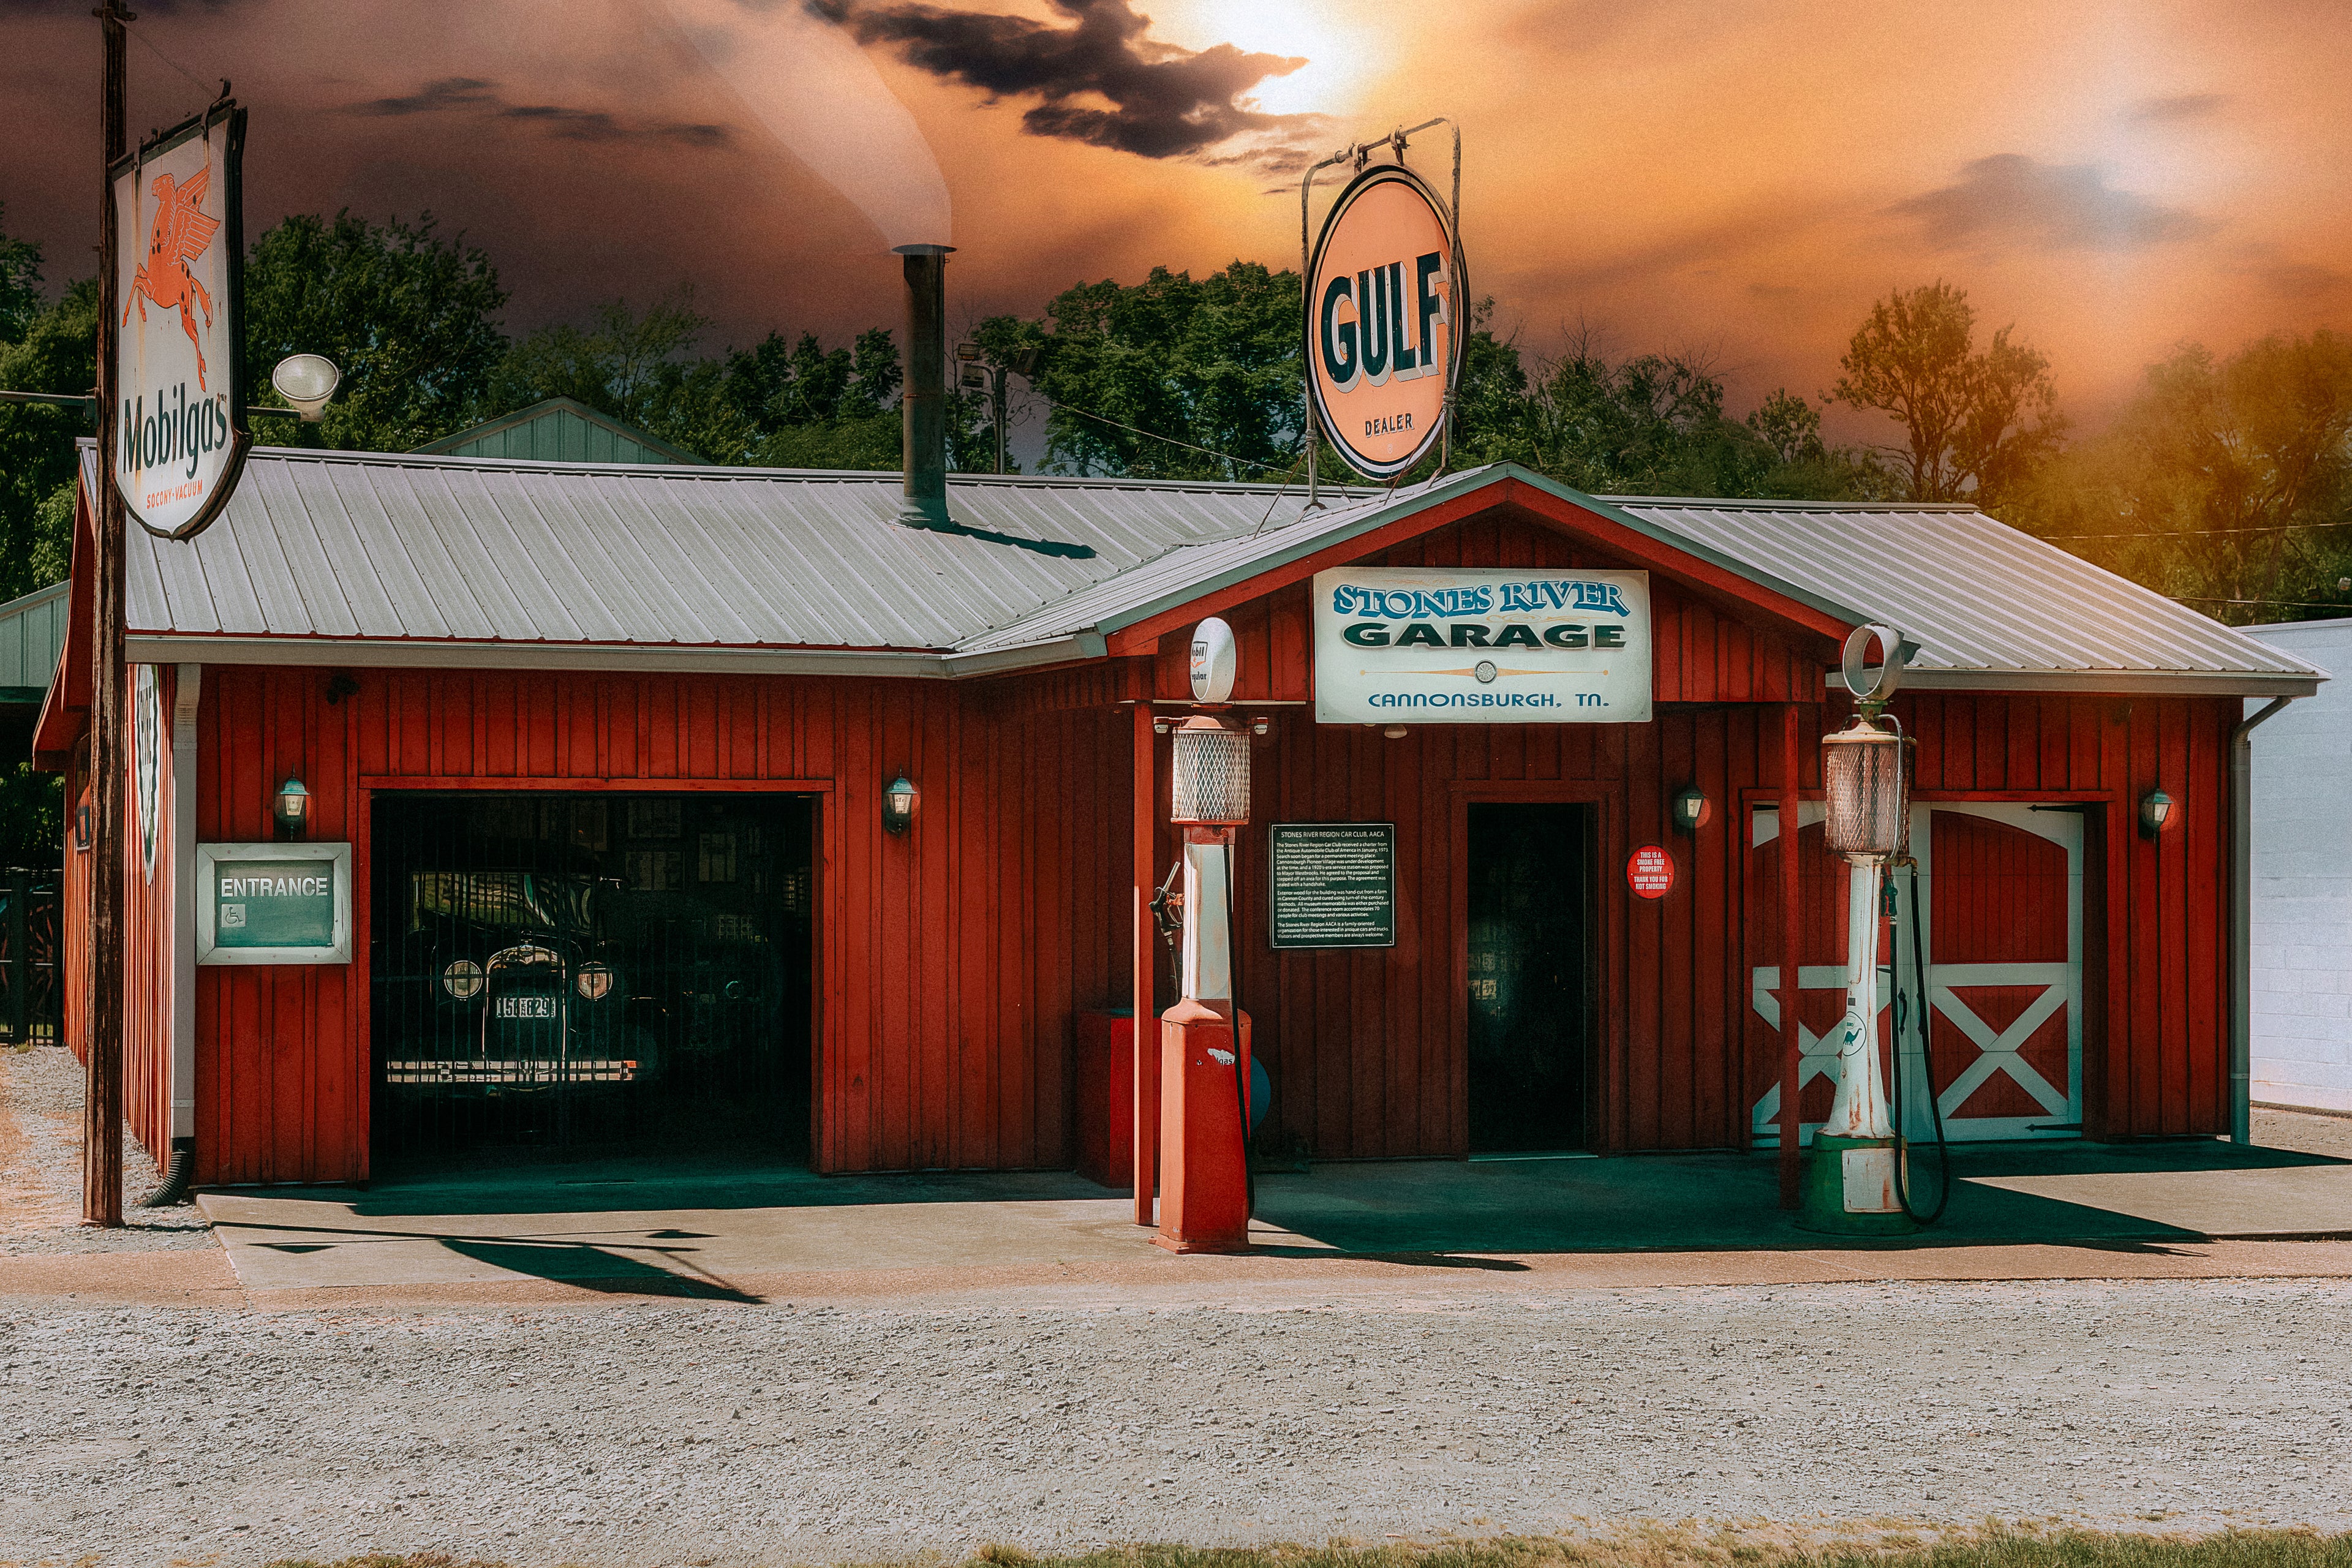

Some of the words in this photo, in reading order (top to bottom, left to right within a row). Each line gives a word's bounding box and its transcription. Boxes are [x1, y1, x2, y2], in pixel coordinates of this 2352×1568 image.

[1321, 251, 1448, 393] GULF
[124, 383, 227, 480] Mobilgas
[1365, 413, 1414, 438] DEALER
[1333, 584, 1494, 619] STONES
[1500, 581, 1630, 617] RIVER
[1343, 623, 1627, 649] GARAGE
[1192, 646, 1205, 657] obil
[1368, 693, 1562, 709] CANNONSBURGH,
[1575, 693, 1609, 707] TN.
[221, 878, 328, 897] ENTRANCE
